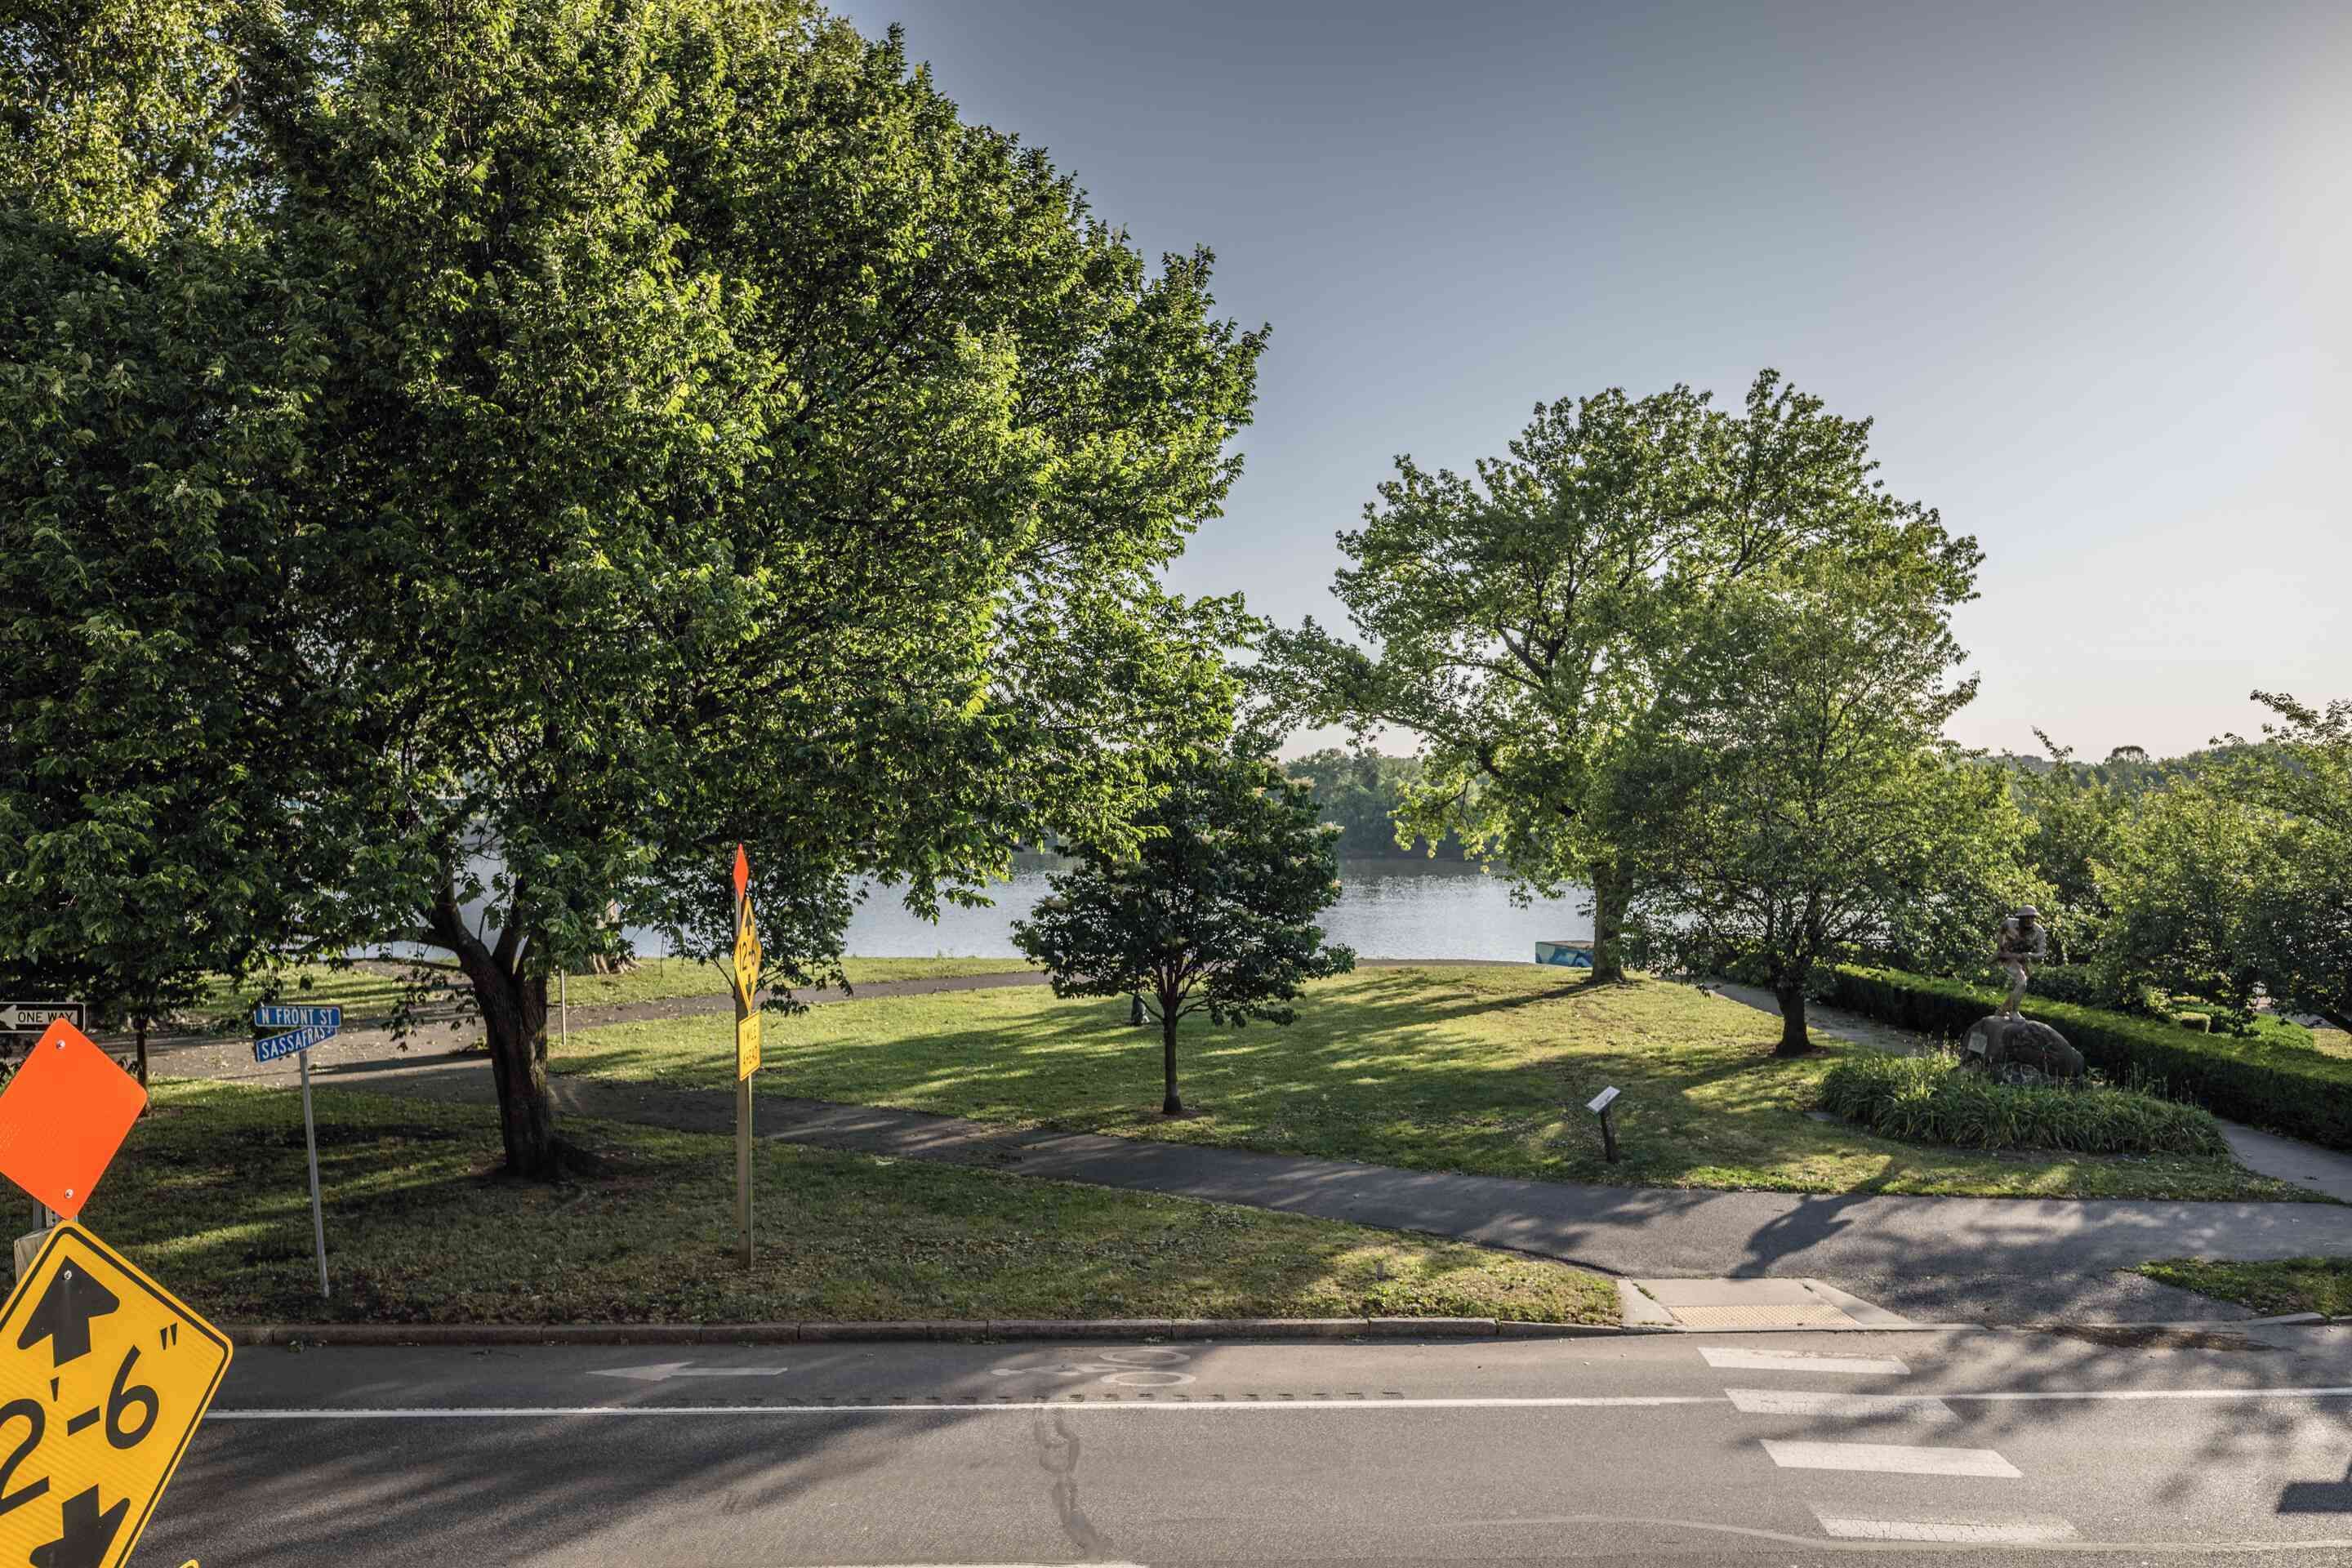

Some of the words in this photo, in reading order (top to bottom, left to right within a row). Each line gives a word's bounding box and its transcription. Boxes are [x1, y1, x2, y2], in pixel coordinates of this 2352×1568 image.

[18, 1012, 43, 1022] ONE
[261, 1009, 270, 1024] N
[276, 1009, 314, 1024] FRONT
[319, 1009, 332, 1025] ST
[261, 1026, 325, 1059] SASSAFRAS
